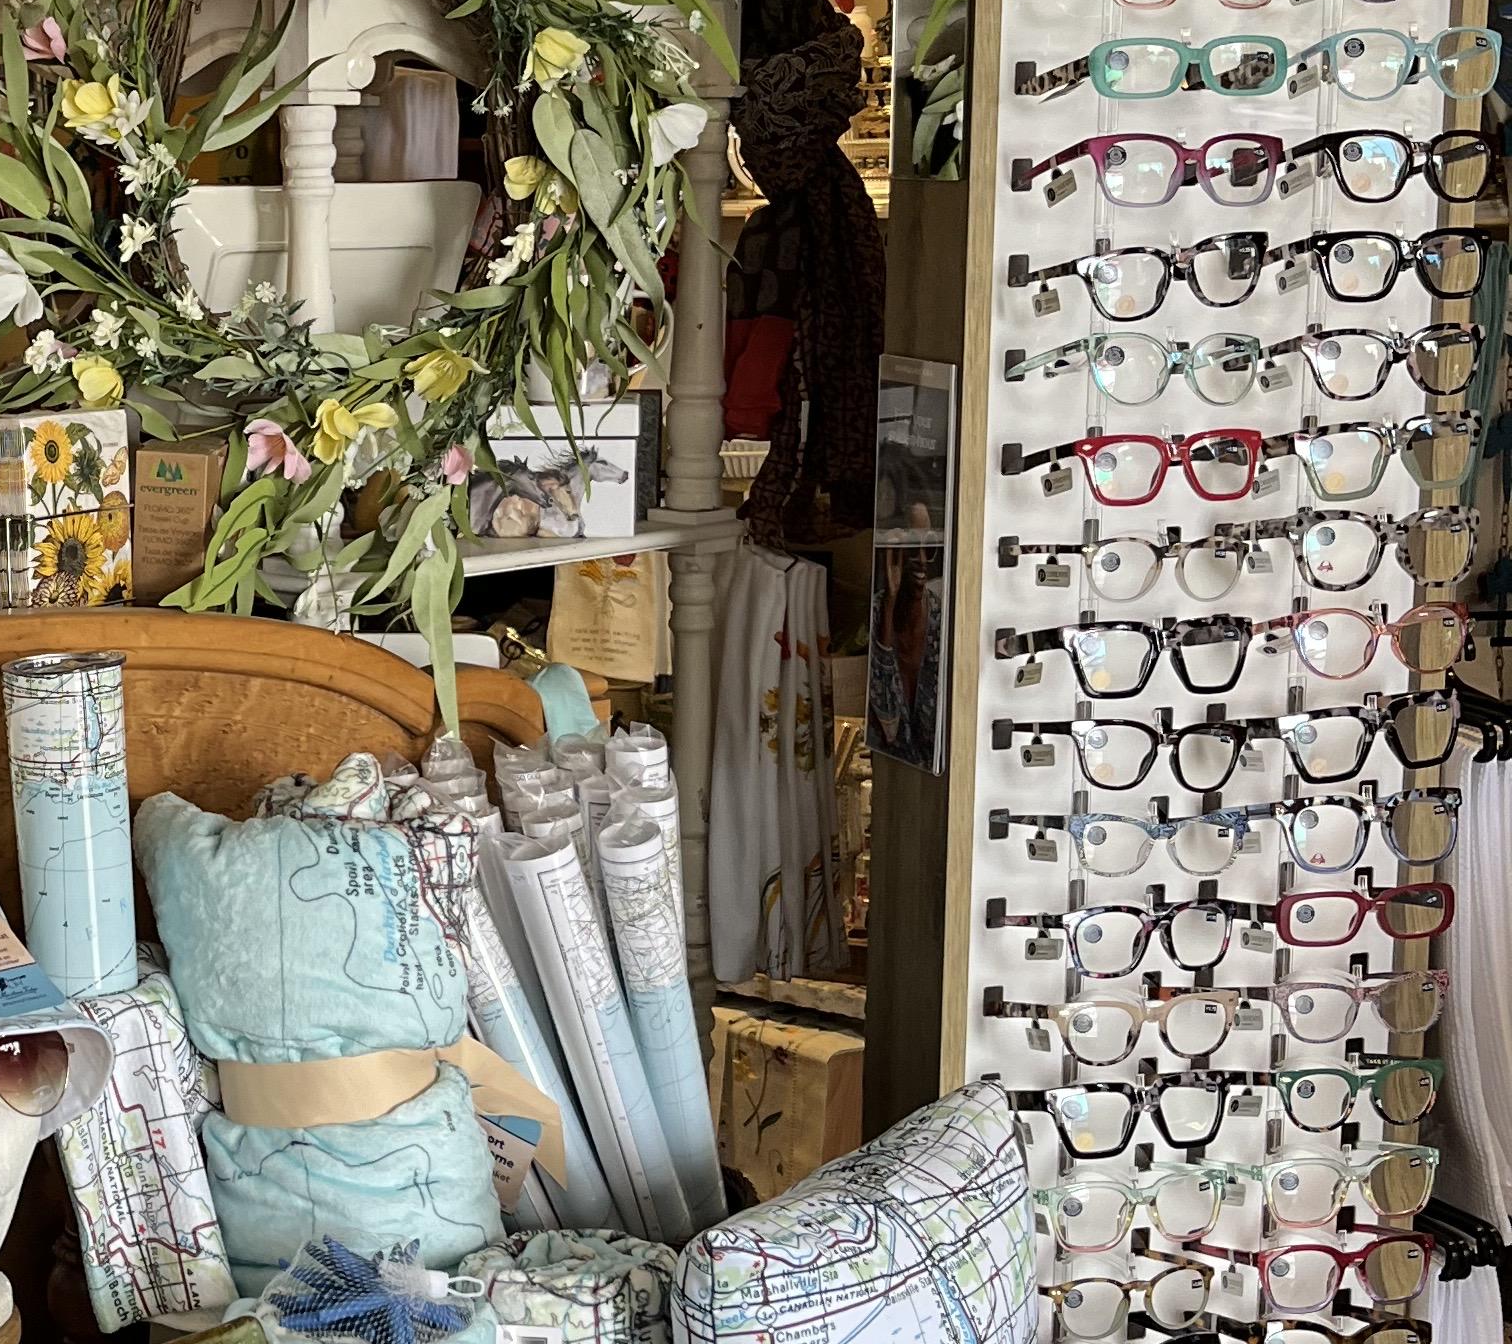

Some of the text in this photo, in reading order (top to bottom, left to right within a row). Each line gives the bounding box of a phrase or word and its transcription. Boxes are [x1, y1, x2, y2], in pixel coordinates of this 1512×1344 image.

[139, 484, 199, 497] evergreen
[343, 860, 360, 898] Spoil
[362, 864, 376, 897] area
[151, 1127, 169, 1150] 17
[487, 1135, 506, 1151] ort
[106, 1165, 126, 1226] NATIONAL
[108, 1279, 129, 1323] Beach
[739, 1276, 818, 1301] Marshallville
[775, 1320, 837, 1344] Chambers
